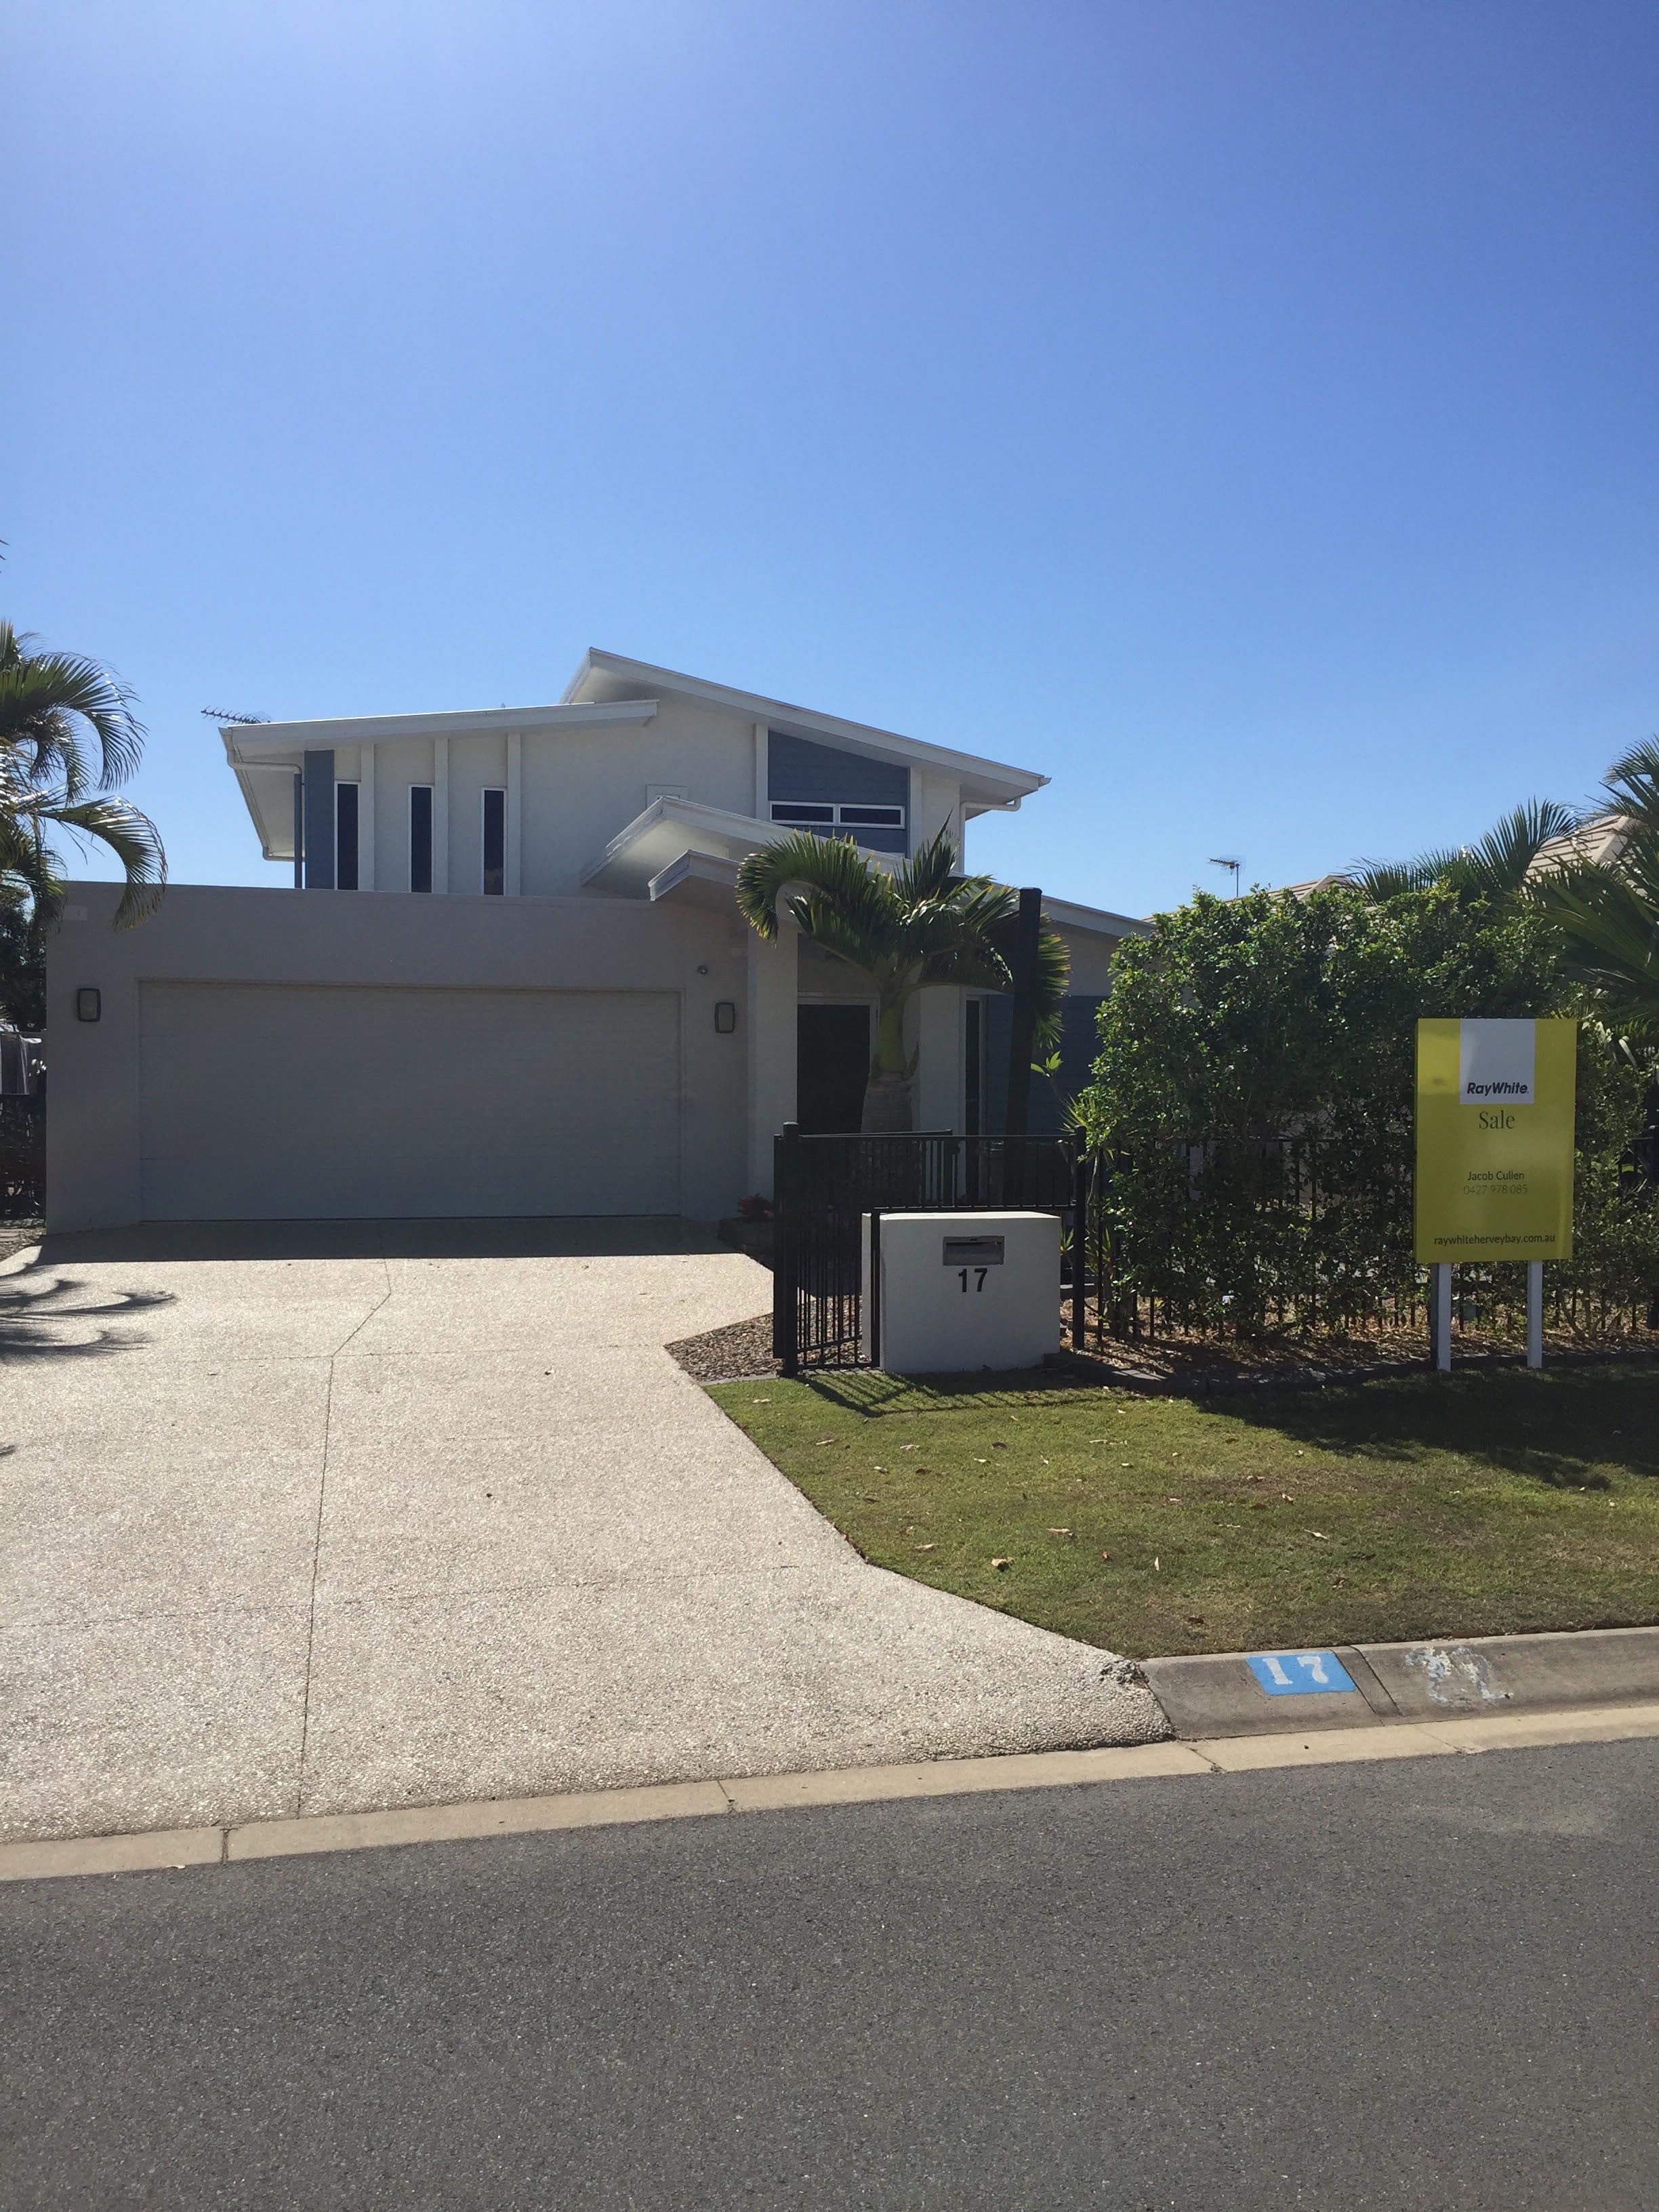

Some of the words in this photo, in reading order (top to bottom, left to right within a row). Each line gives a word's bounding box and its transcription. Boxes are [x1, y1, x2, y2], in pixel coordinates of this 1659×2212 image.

[1479, 1109, 1515, 1130] Sale
[1467, 1171, 1494, 1181] Jacob
[1496, 1171, 1525, 1180] Cullen
[1434, 1234, 1555, 1246] raywhiteherveybay.com.au
[958, 1267, 987, 1292] 17
[1262, 1655, 1329, 1685] 17
